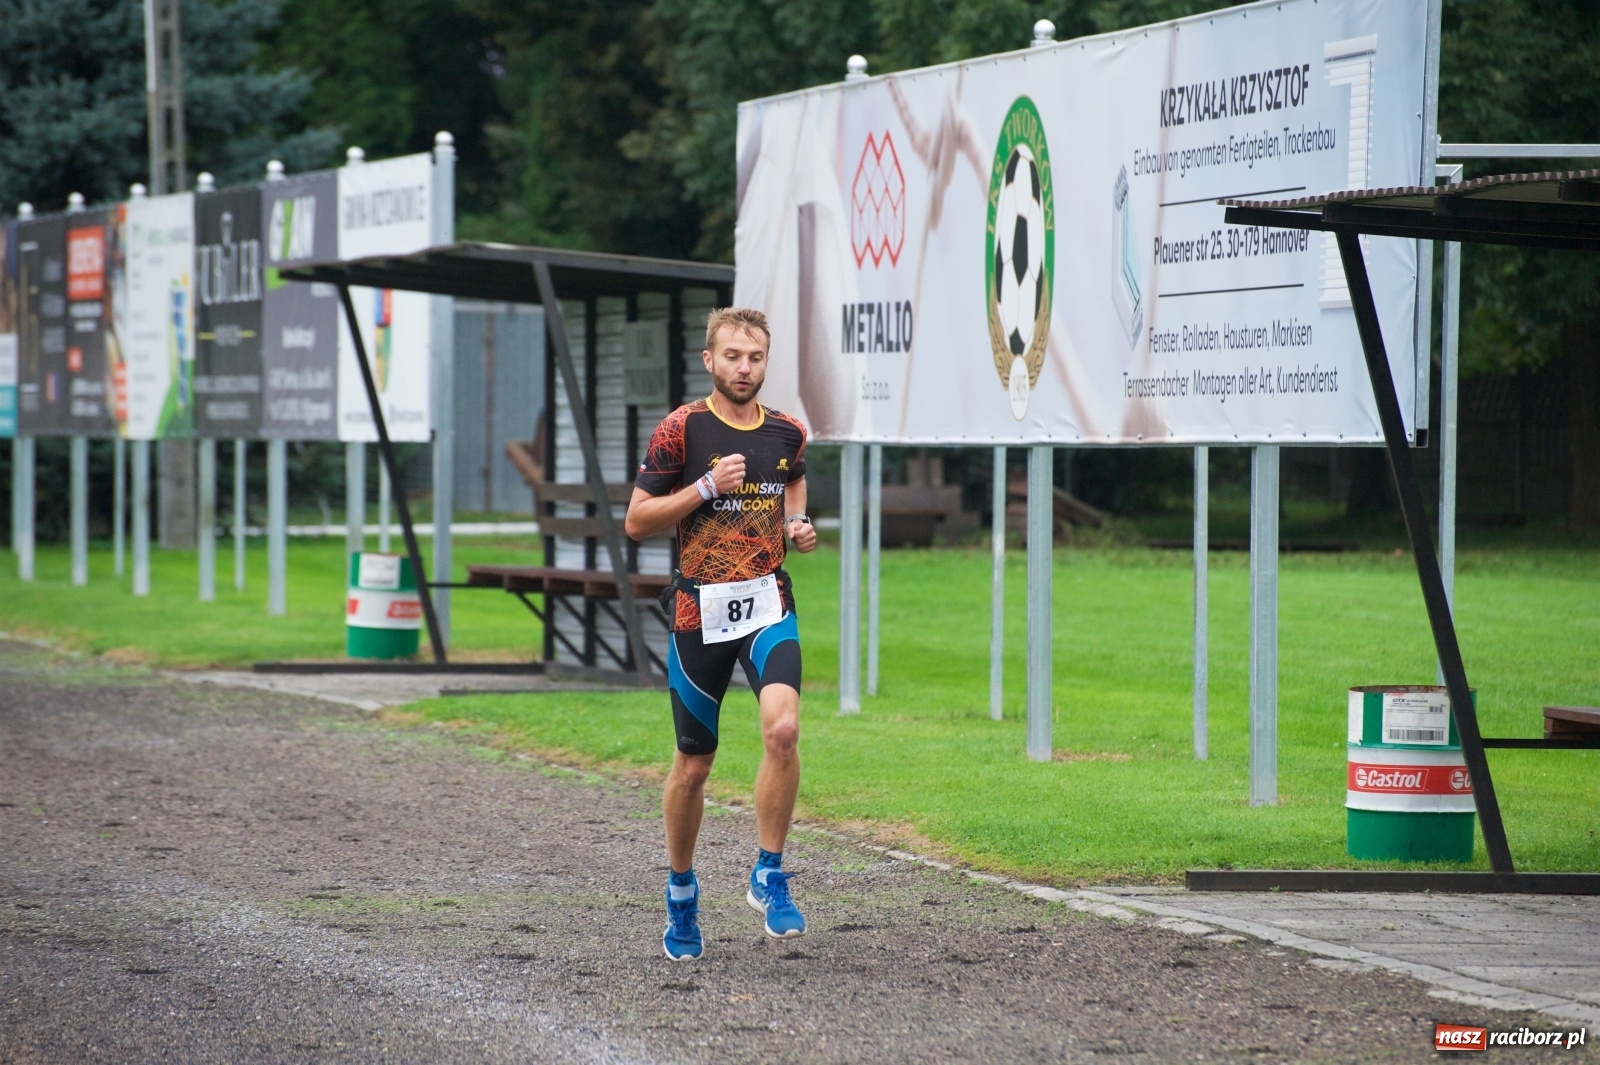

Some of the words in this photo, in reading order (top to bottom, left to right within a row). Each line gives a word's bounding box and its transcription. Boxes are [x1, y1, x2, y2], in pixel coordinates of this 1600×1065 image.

[1160, 79, 1227, 128] KRZYKAŁA
[1231, 64, 1309, 117] KRZYSZTOF
[1134, 149, 1161, 176] Einbau
[1163, 150, 1178, 172] von
[1181, 142, 1226, 178] genormten
[1229, 130, 1281, 169] Fertigteilen,
[1284, 122, 1336, 155] Trockenbau
[1154, 235, 1194, 265] Plauener
[1196, 235, 1209, 262] str
[1227, 226, 1259, 258] 30-179
[1262, 226, 1309, 255] Hannover
[841, 300, 913, 354] METALIO
[1149, 327, 1180, 355] Fenster,
[1272, 318, 1312, 348] Markisen
[1123, 370, 1189, 398] Terrassendacher
[1193, 369, 1236, 403] Montagen
[1239, 366, 1257, 394] aller
[1277, 364, 1338, 394] Kundendienst
[712, 497, 775, 511] CANGÓRY
[727, 597, 755, 622] 87
[1367, 770, 1421, 788] Castrol
